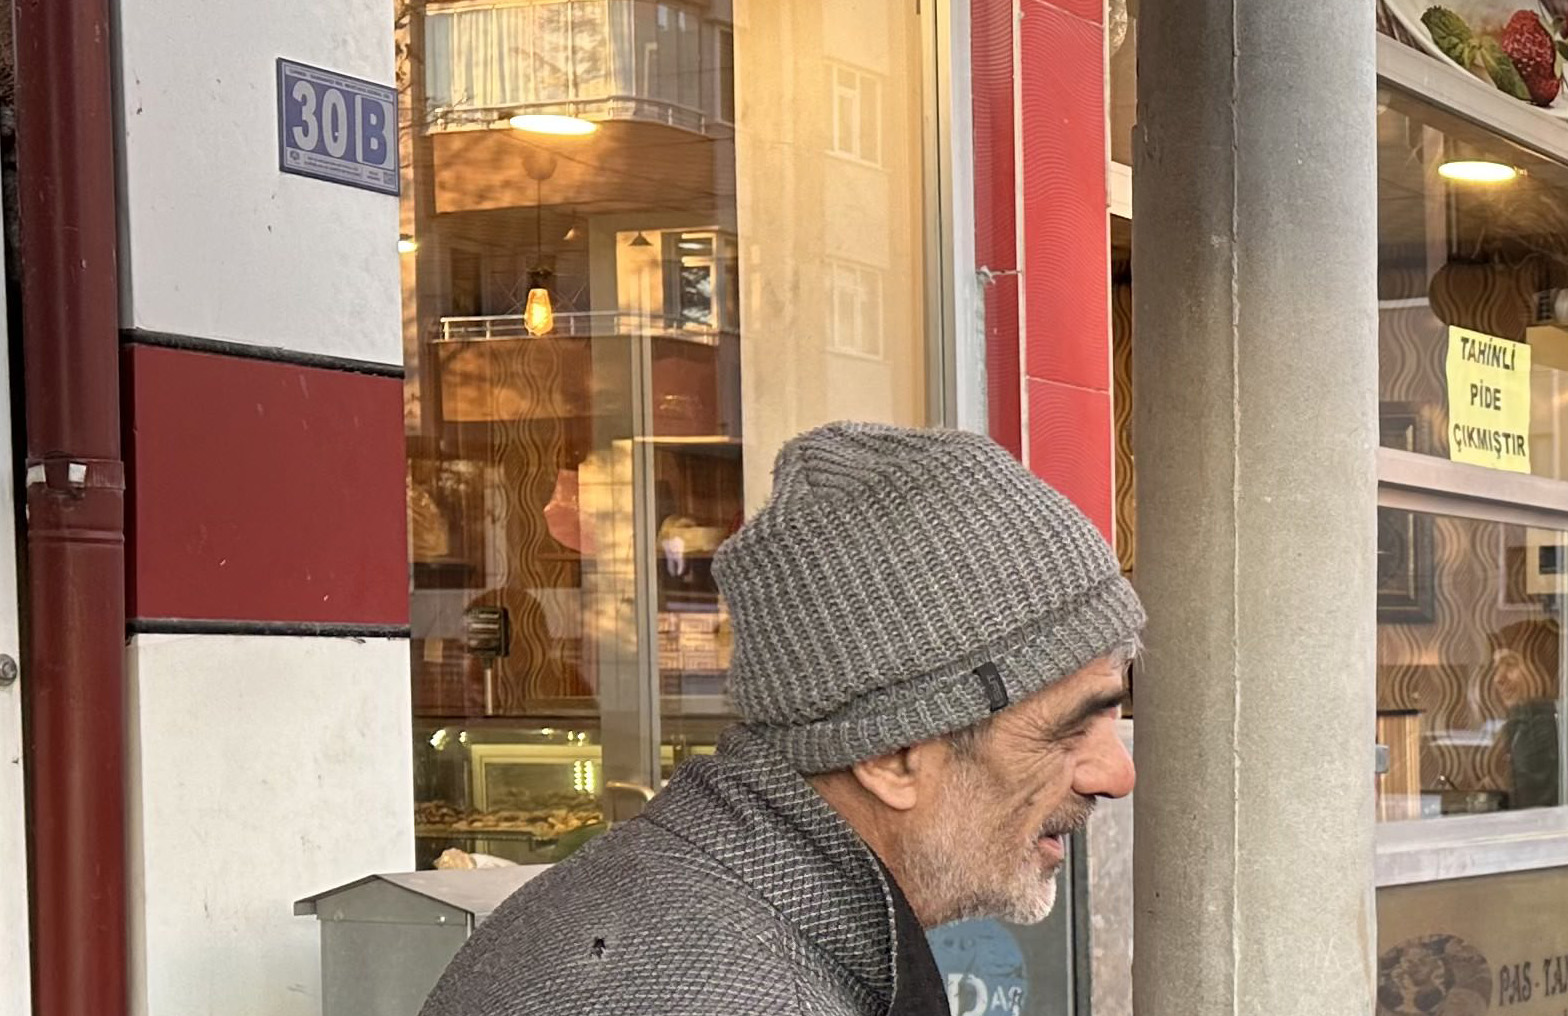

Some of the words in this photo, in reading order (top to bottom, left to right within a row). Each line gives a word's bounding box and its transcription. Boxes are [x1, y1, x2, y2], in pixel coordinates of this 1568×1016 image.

[1460, 337, 1515, 371] TAHİNLİ
[1470, 379, 1502, 411] PİDE
[1453, 423, 1526, 459] ÇIKMIŞTIR
[1499, 961, 1532, 1007] PAS
